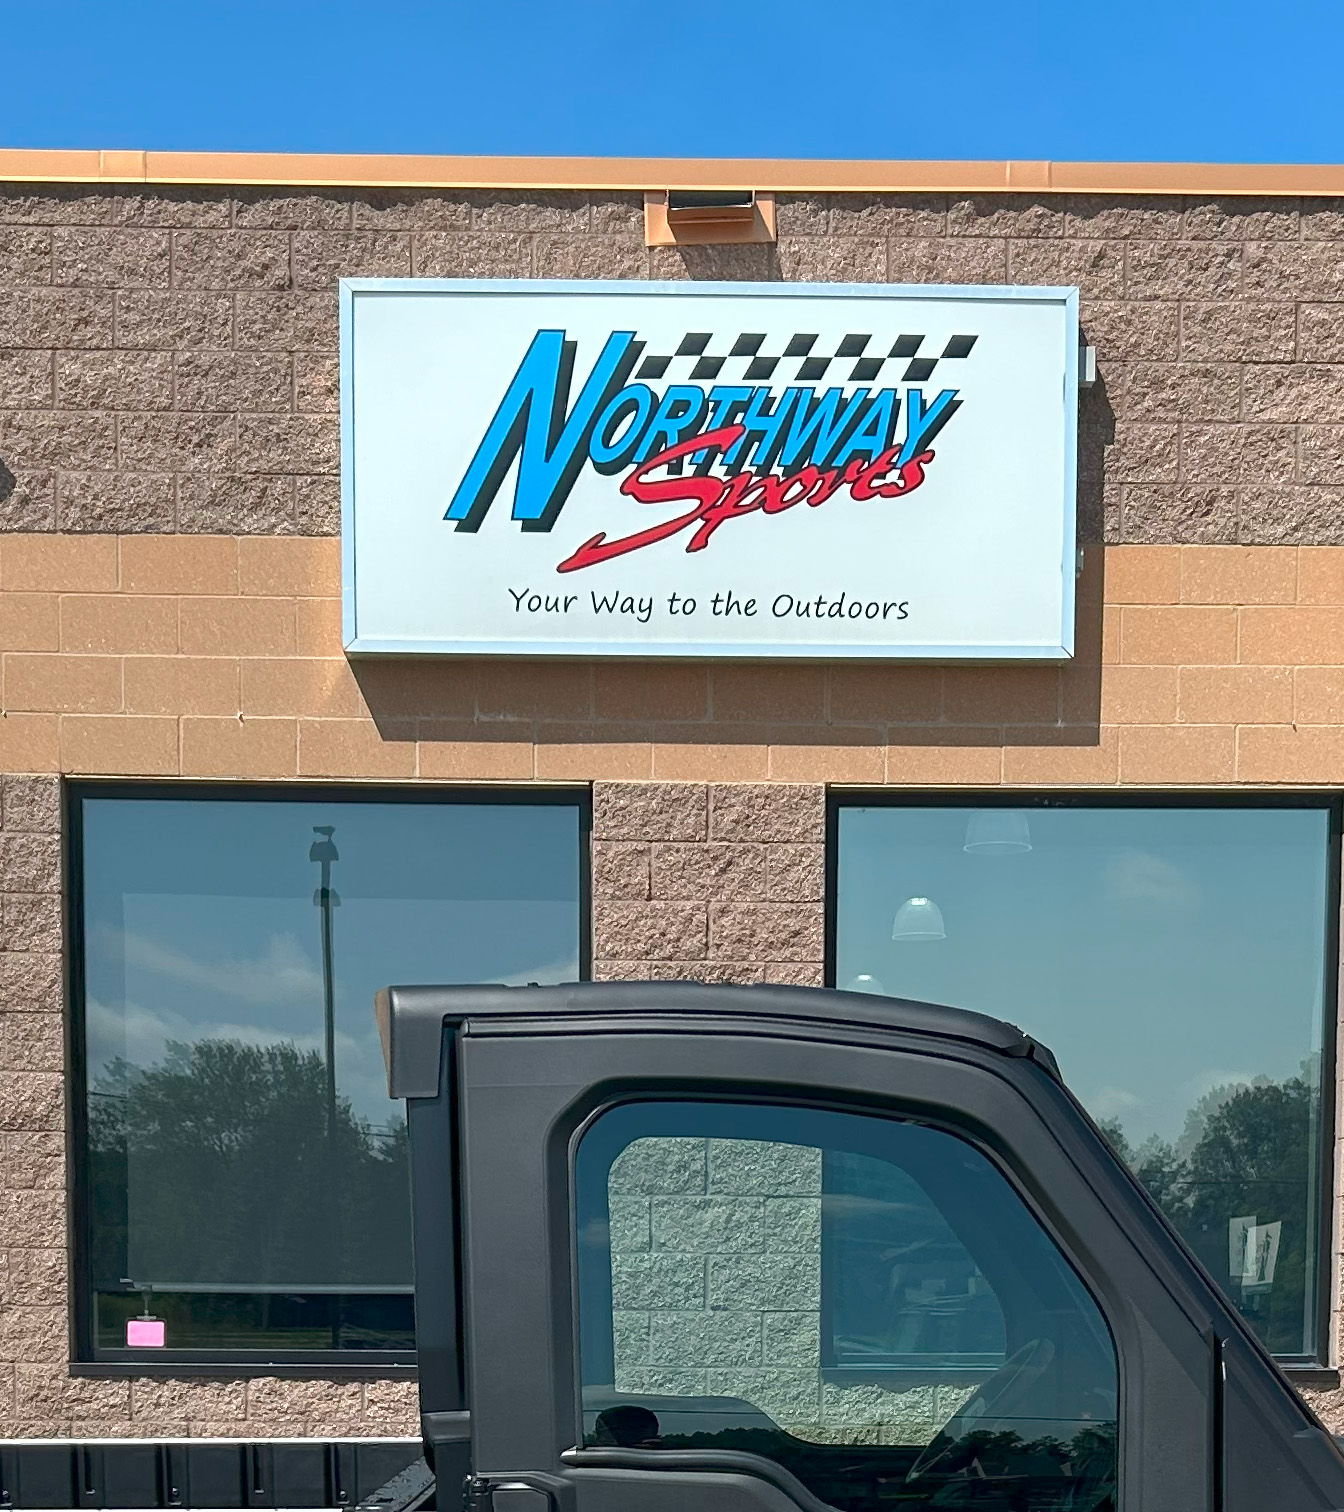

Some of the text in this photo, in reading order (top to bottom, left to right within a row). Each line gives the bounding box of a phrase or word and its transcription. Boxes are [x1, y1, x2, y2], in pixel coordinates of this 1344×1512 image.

[443, 328, 963, 533] NORTHWAY
[556, 423, 935, 573] Sports
[507, 587, 910, 623] Your Way to the Outdoors
